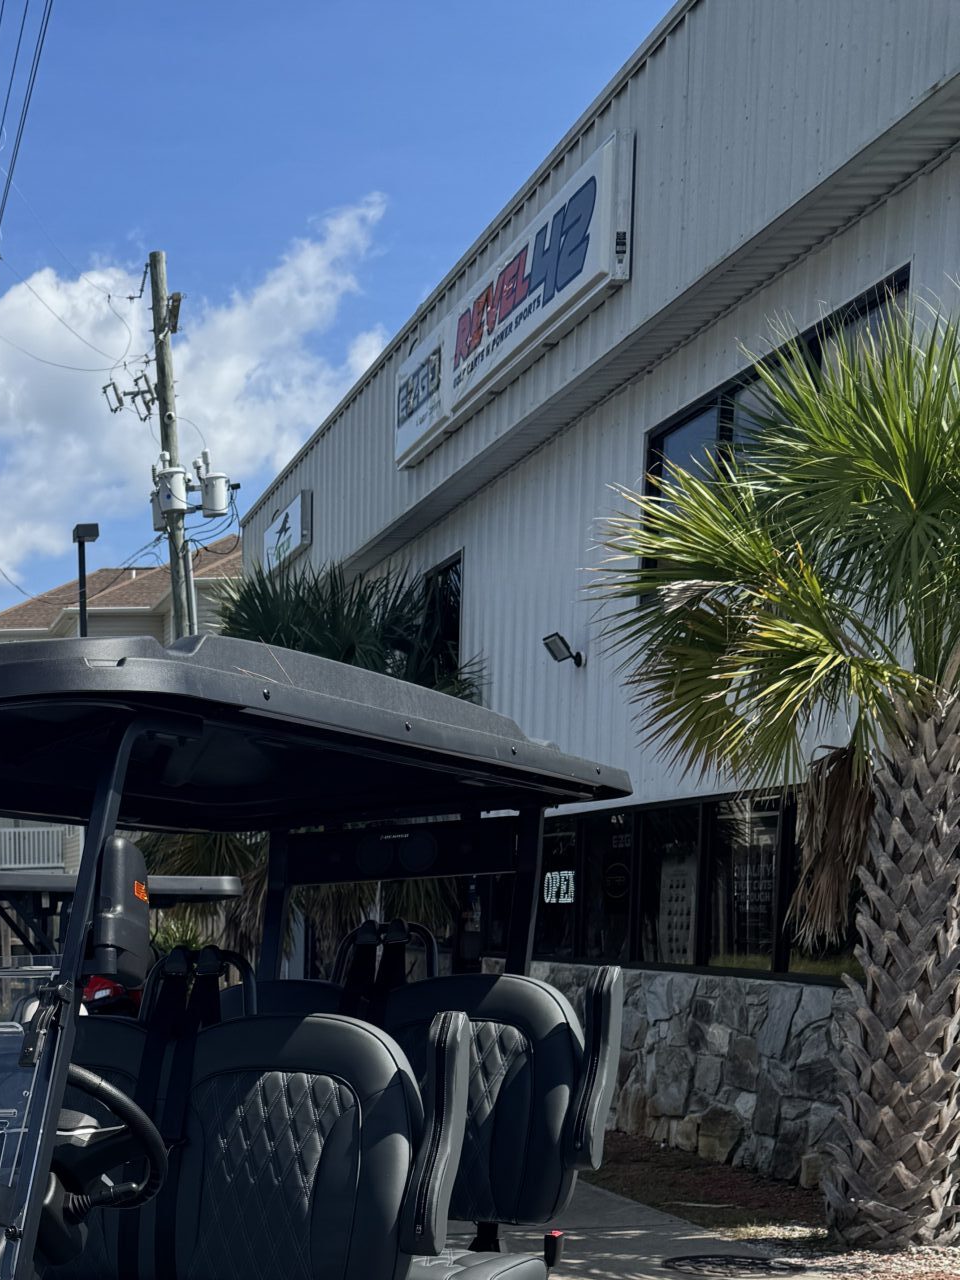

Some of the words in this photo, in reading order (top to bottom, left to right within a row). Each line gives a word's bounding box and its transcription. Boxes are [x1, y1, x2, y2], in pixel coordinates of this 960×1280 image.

[491, 321, 513, 351] POWER
[514, 293, 542, 330] SPORTS
[543, 870, 575, 903] OPEN
